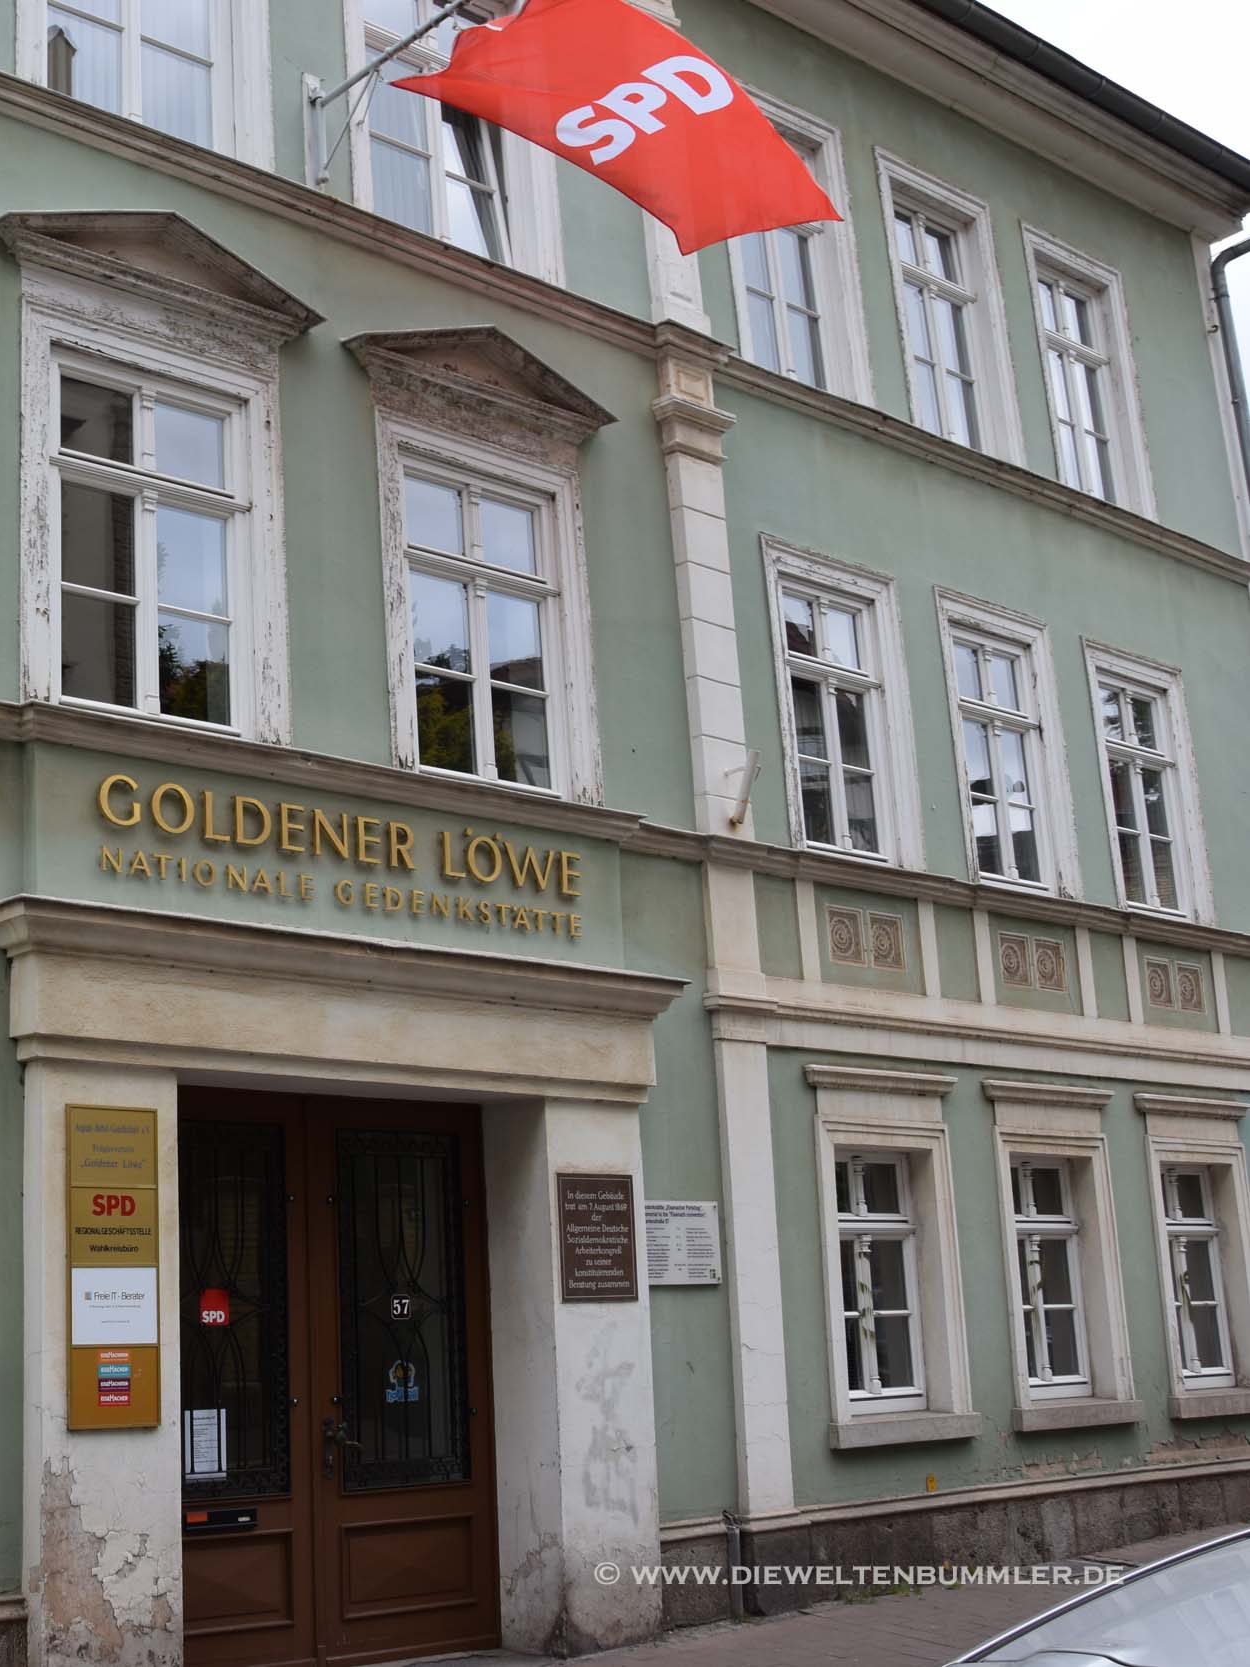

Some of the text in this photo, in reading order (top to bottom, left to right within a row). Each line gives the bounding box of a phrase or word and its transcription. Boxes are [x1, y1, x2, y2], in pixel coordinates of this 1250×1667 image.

[556, 55, 734, 166] SPD
[97, 773, 583, 897] GOLDENER LÖWE
[99, 845, 584, 941] NATIONALE GEDENKSTÄTTE
[92, 1193, 136, 1216] SPD
[591, 1213, 602, 1222] der
[566, 1223, 629, 1234] Allgemeine Deutsche
[89, 1244, 139, 1253] Wahlkreisbüro
[94, 1291, 110, 1301] Freie
[121, 1291, 145, 1301] Berater
[393, 1299, 409, 1315] 57
[202, 1310, 225, 1323] SPD
